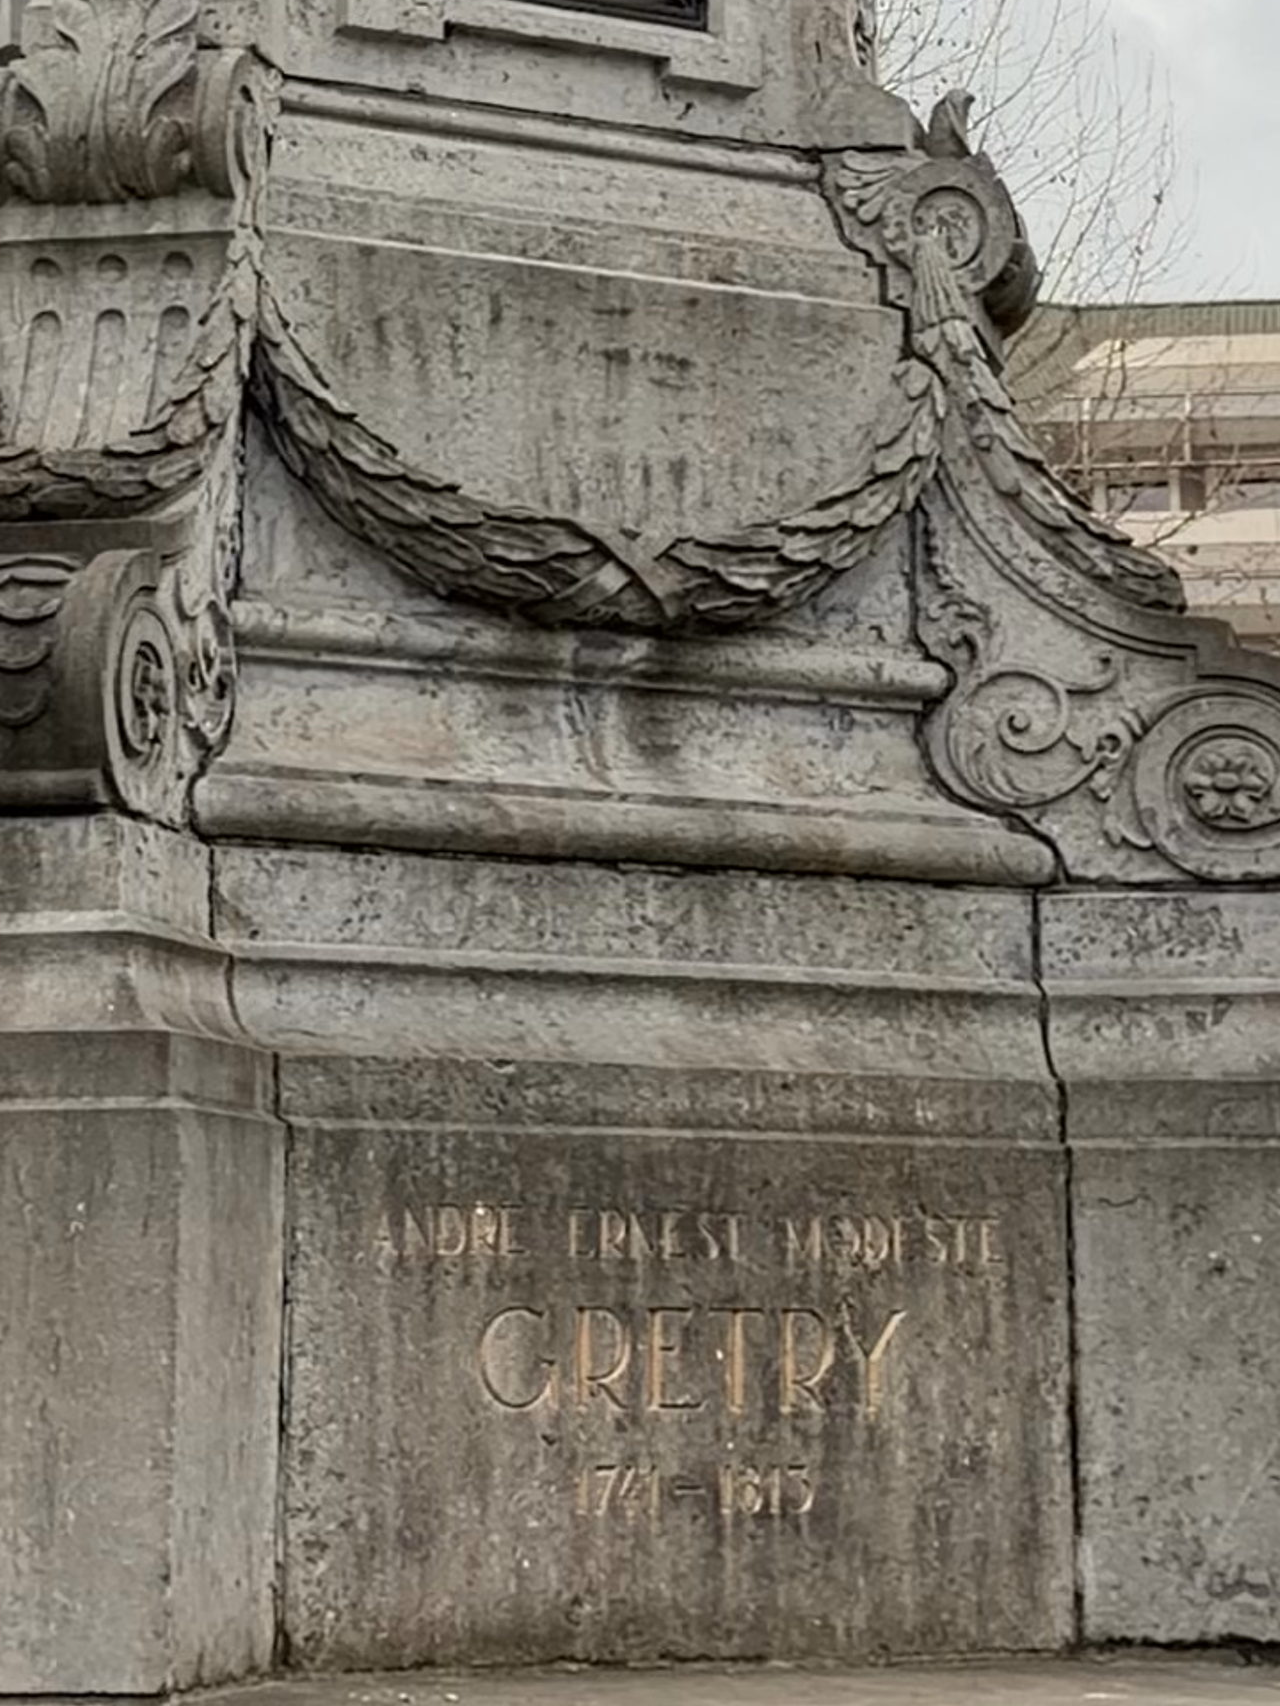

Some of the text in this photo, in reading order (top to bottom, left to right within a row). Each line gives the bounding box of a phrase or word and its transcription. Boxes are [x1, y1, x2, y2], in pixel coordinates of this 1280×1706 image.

[568, 1204, 746, 1261] ERNEST
[782, 1208, 1005, 1264] MODESTE
[479, 1305, 907, 1418] GRETRY
[720, 1464, 815, 1514] 1813
